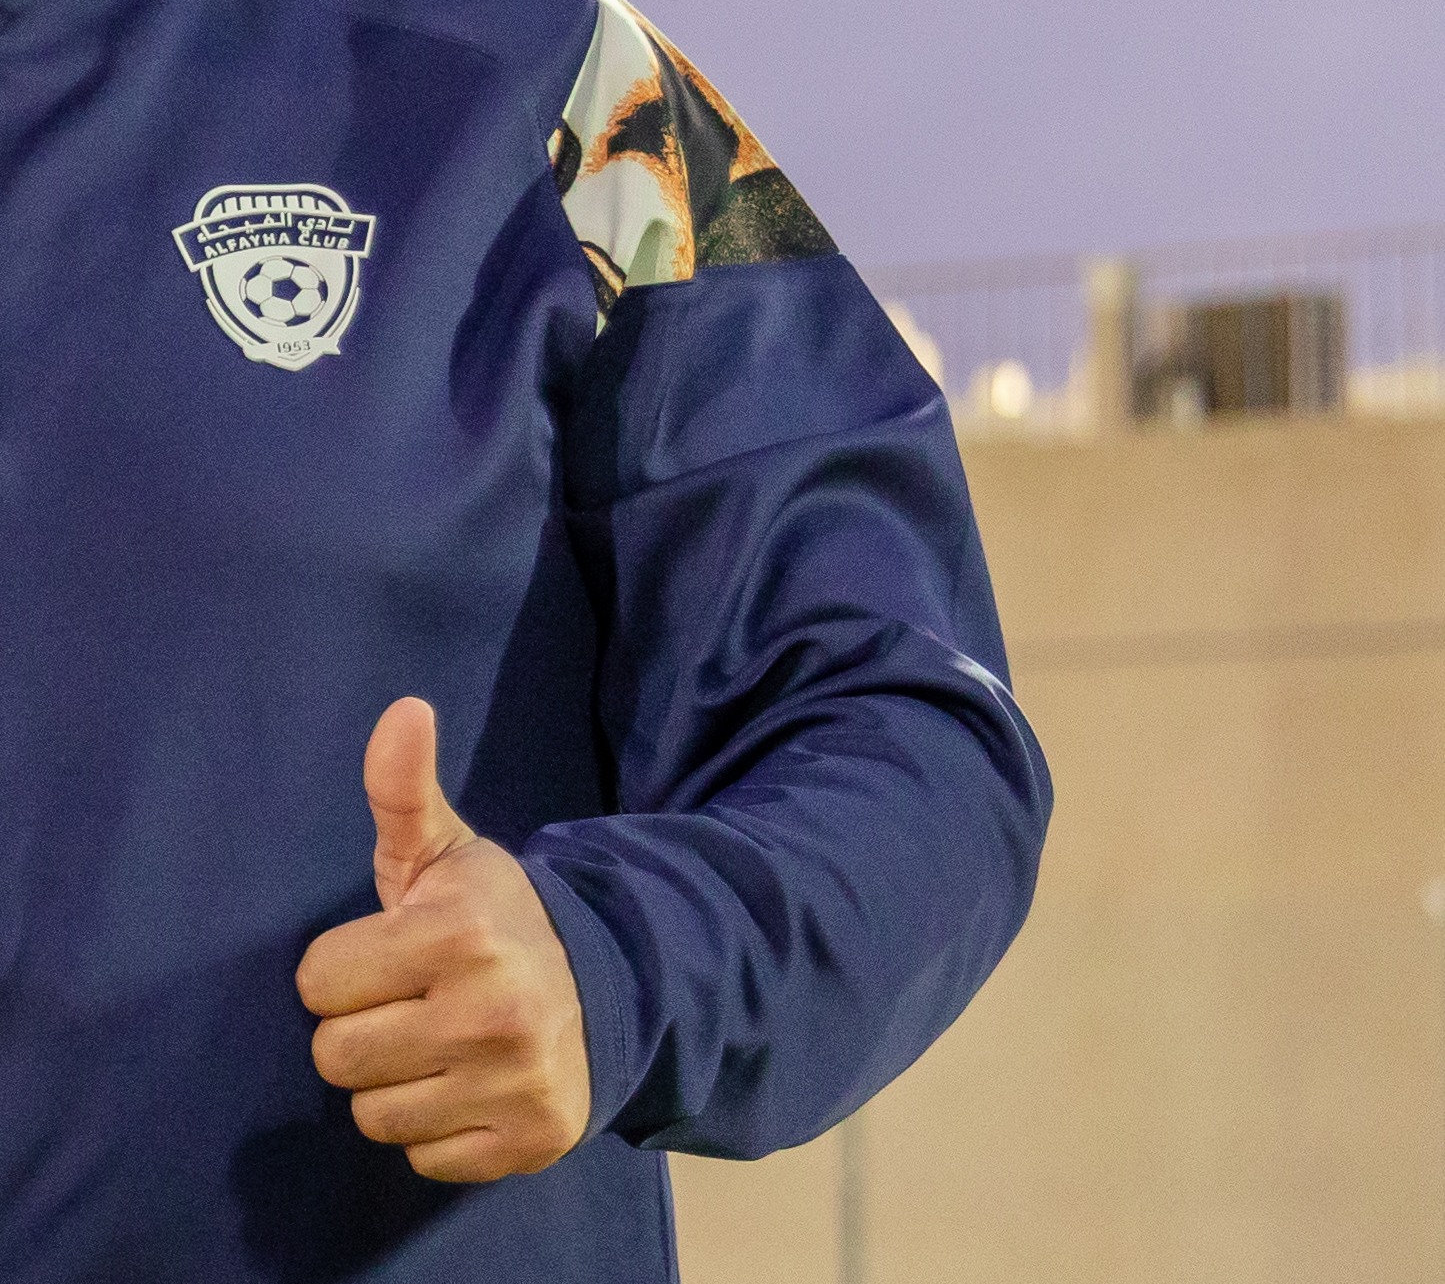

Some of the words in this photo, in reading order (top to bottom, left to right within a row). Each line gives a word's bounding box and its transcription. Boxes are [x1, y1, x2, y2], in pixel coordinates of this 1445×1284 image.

[204, 232, 291, 259] ALFAYHA
[298, 234, 350, 250] CLUB
[277, 339, 311, 353] 1953
